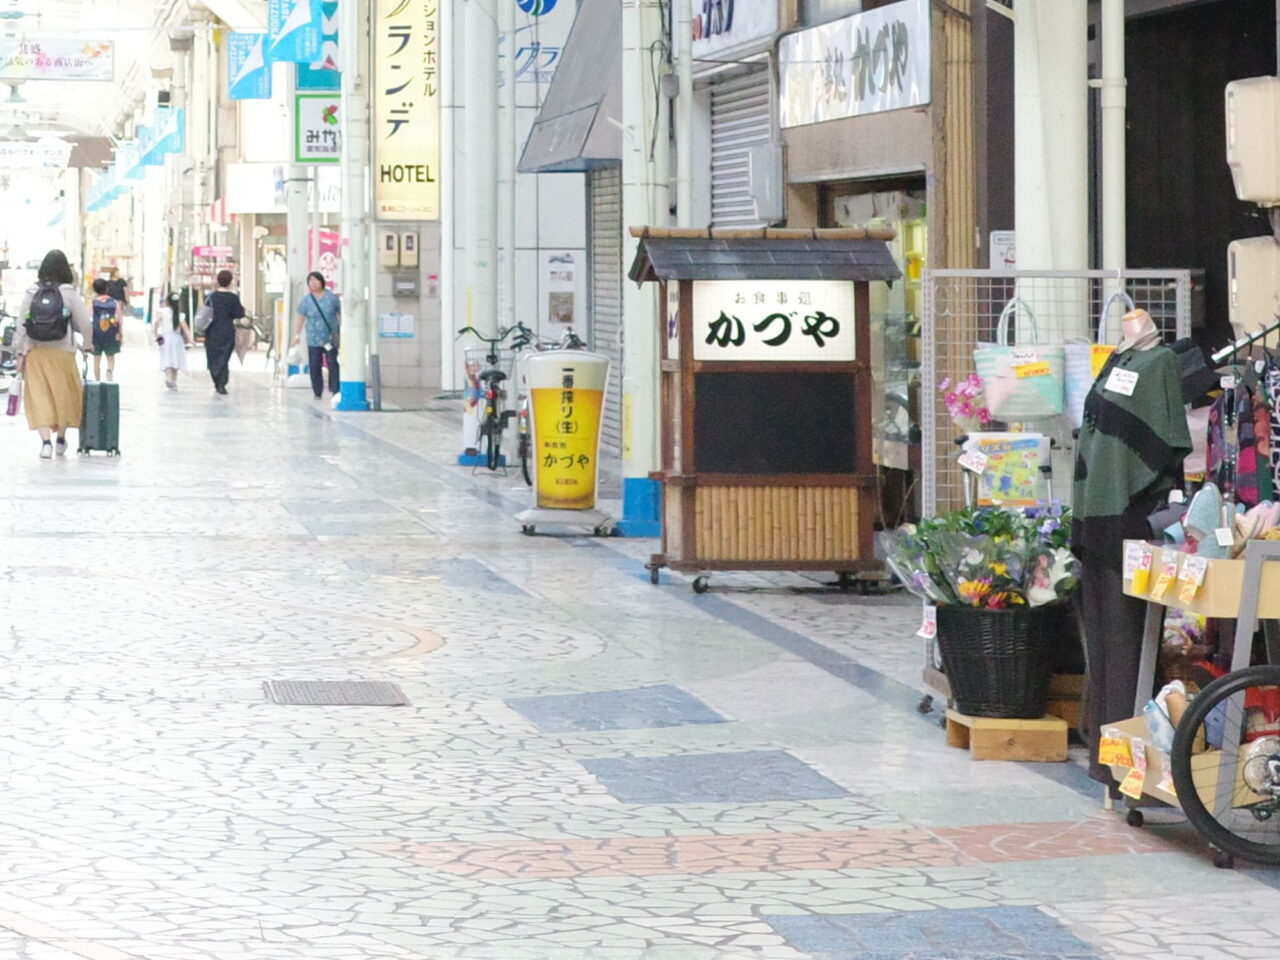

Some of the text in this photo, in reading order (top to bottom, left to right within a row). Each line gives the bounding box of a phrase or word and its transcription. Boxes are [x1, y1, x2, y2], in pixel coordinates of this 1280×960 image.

[305, 128, 341, 148] みや
[380, 164, 436, 183] HOTEL
[734, 290, 812, 305] お食事処
[705, 310, 841, 348] かづや
[543, 453, 590, 470] かづや
